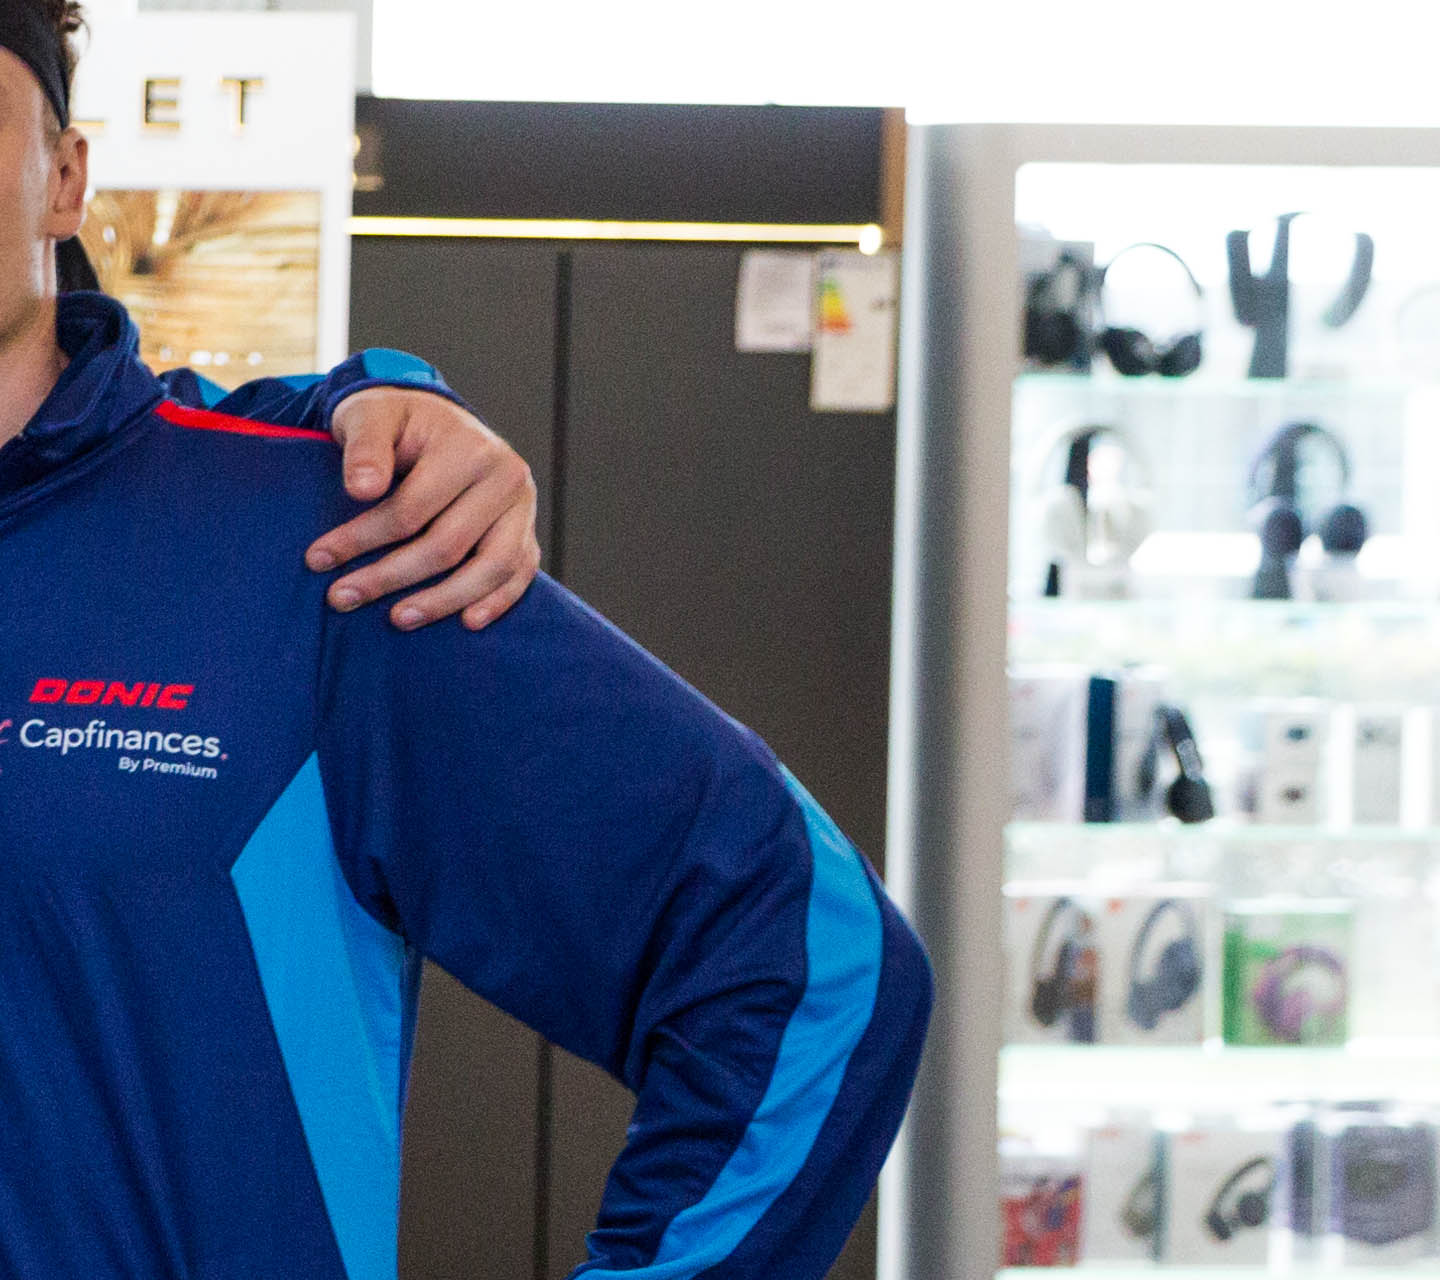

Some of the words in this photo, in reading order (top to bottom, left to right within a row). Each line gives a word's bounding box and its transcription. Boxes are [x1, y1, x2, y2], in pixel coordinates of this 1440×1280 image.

[29, 678, 195, 710] DONIC
[119, 757, 140, 772] By
[143, 758, 218, 779] Premium
